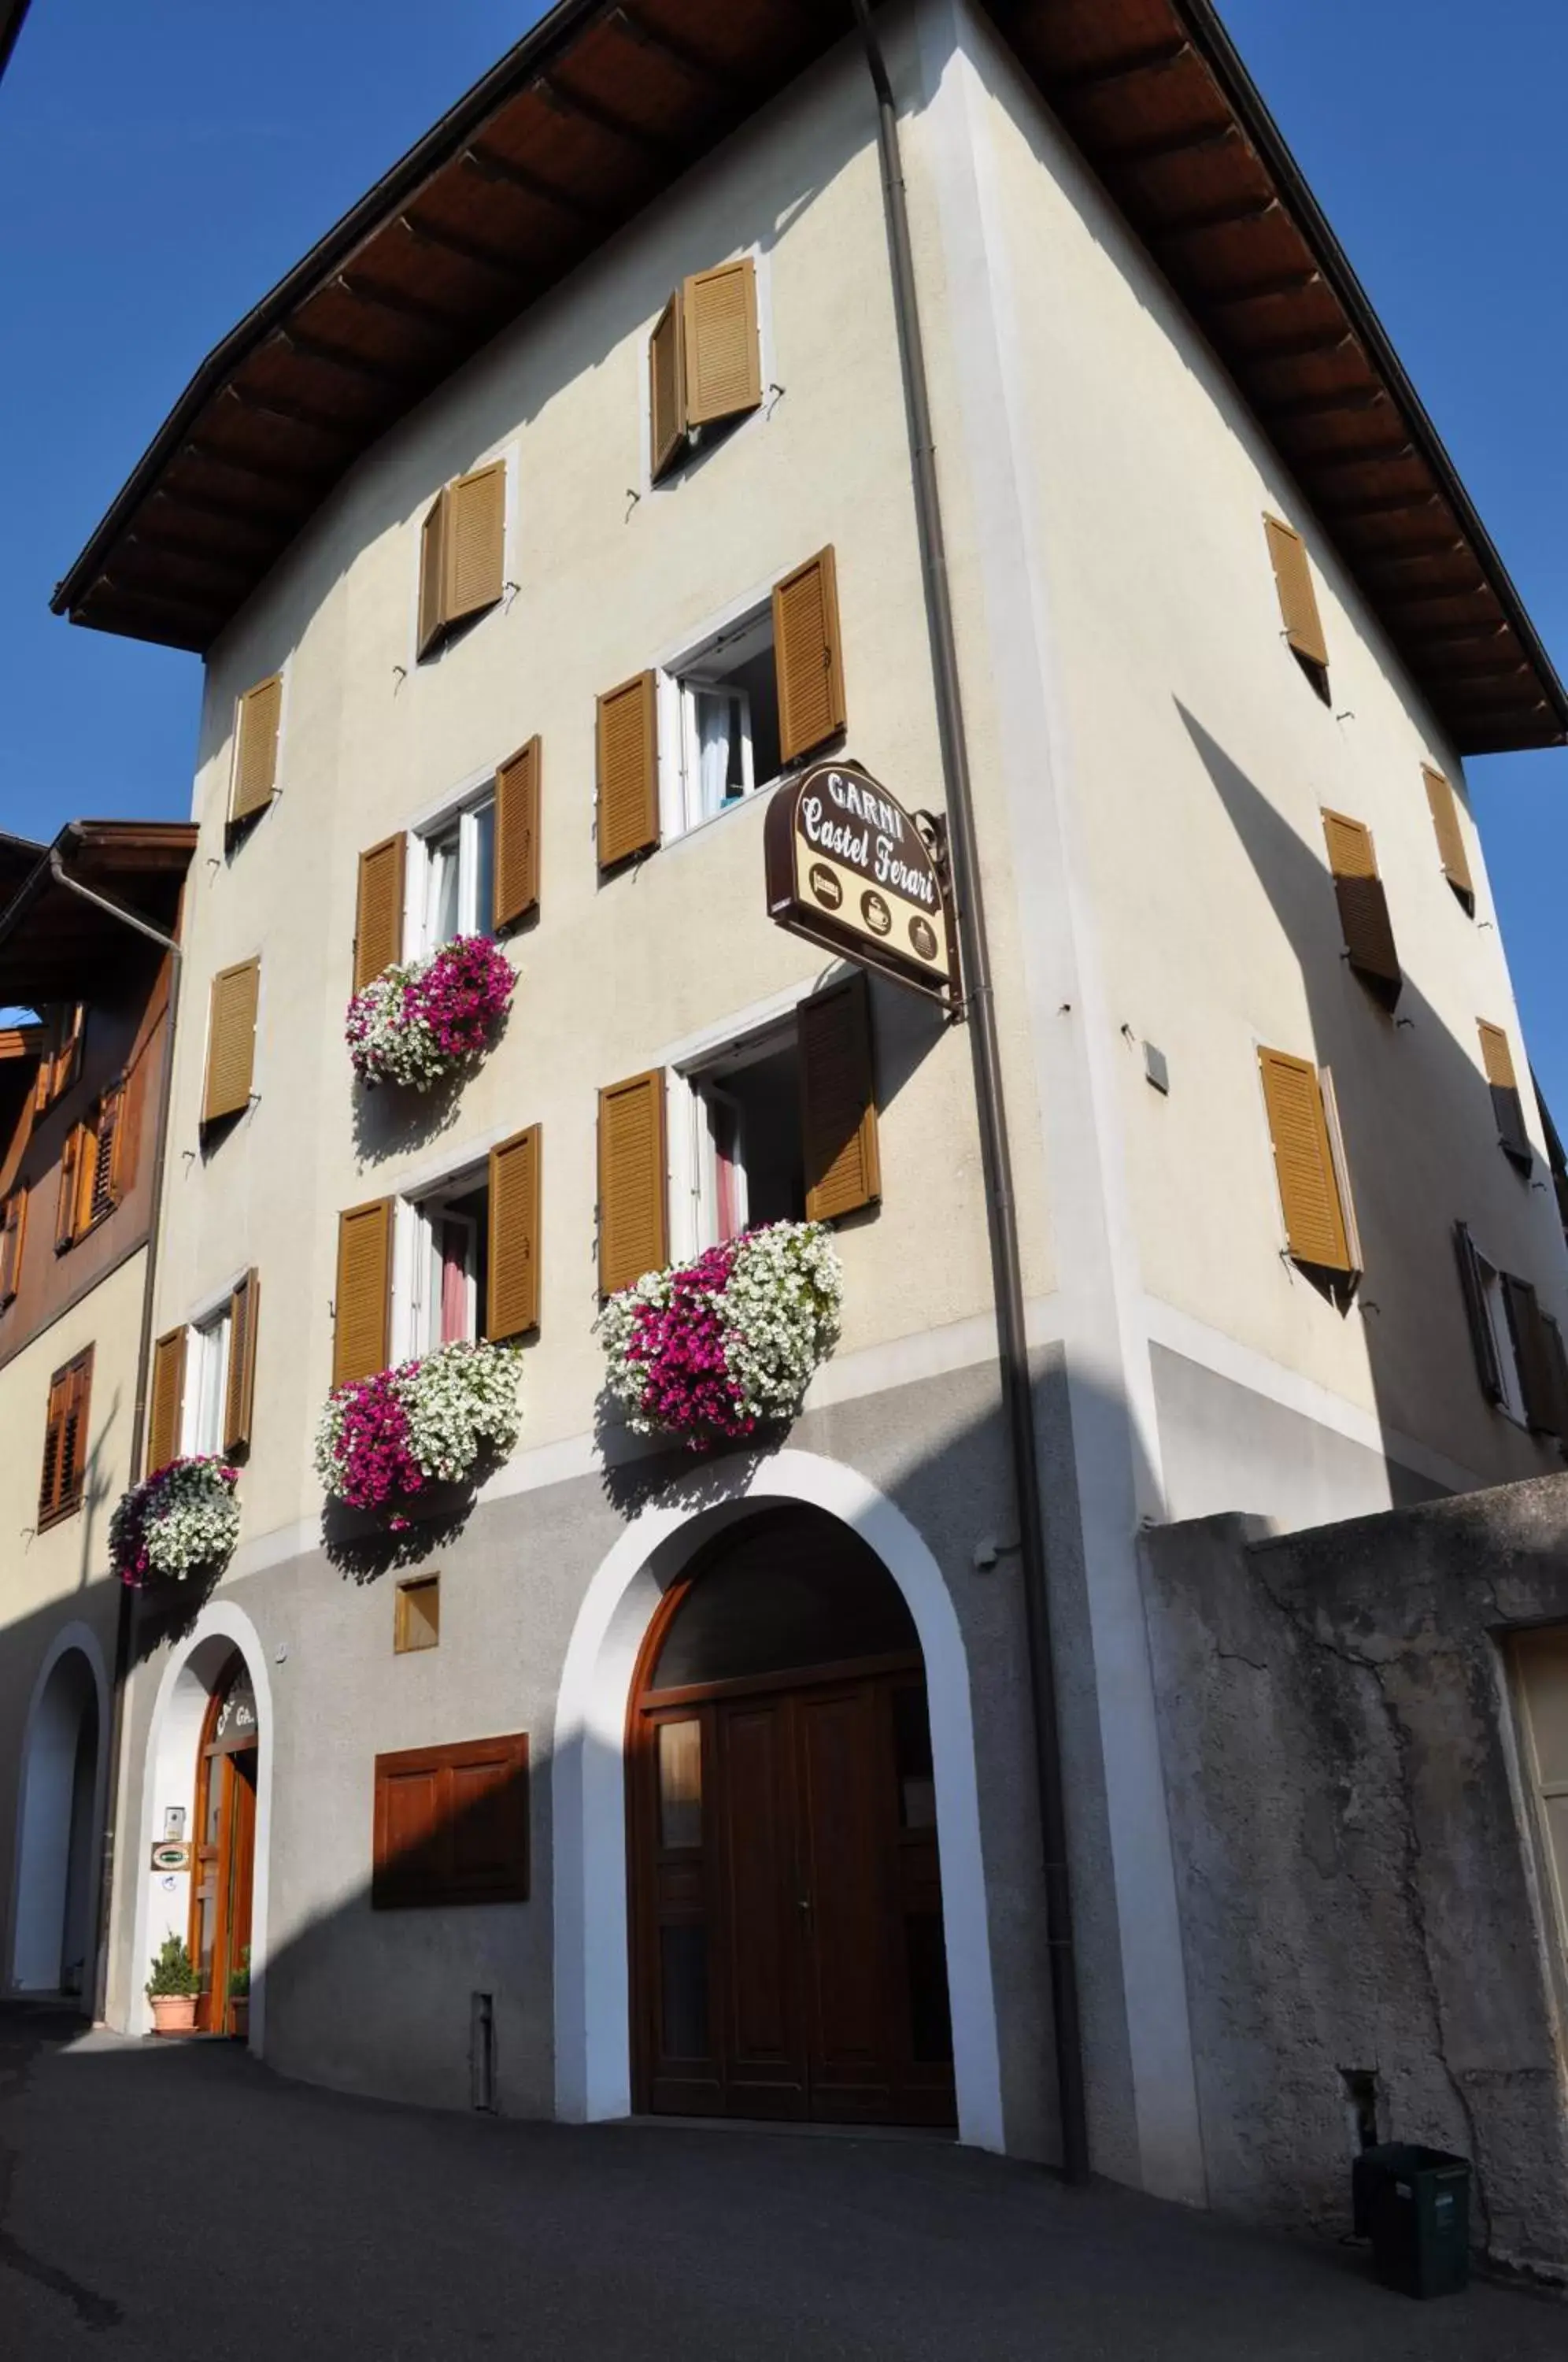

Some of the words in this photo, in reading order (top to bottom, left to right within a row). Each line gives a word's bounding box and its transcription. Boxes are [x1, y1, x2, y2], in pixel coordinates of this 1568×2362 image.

[802, 798, 869, 867] Castel
[875, 835, 934, 904] Ferari
[828, 773, 904, 842] GARNI
